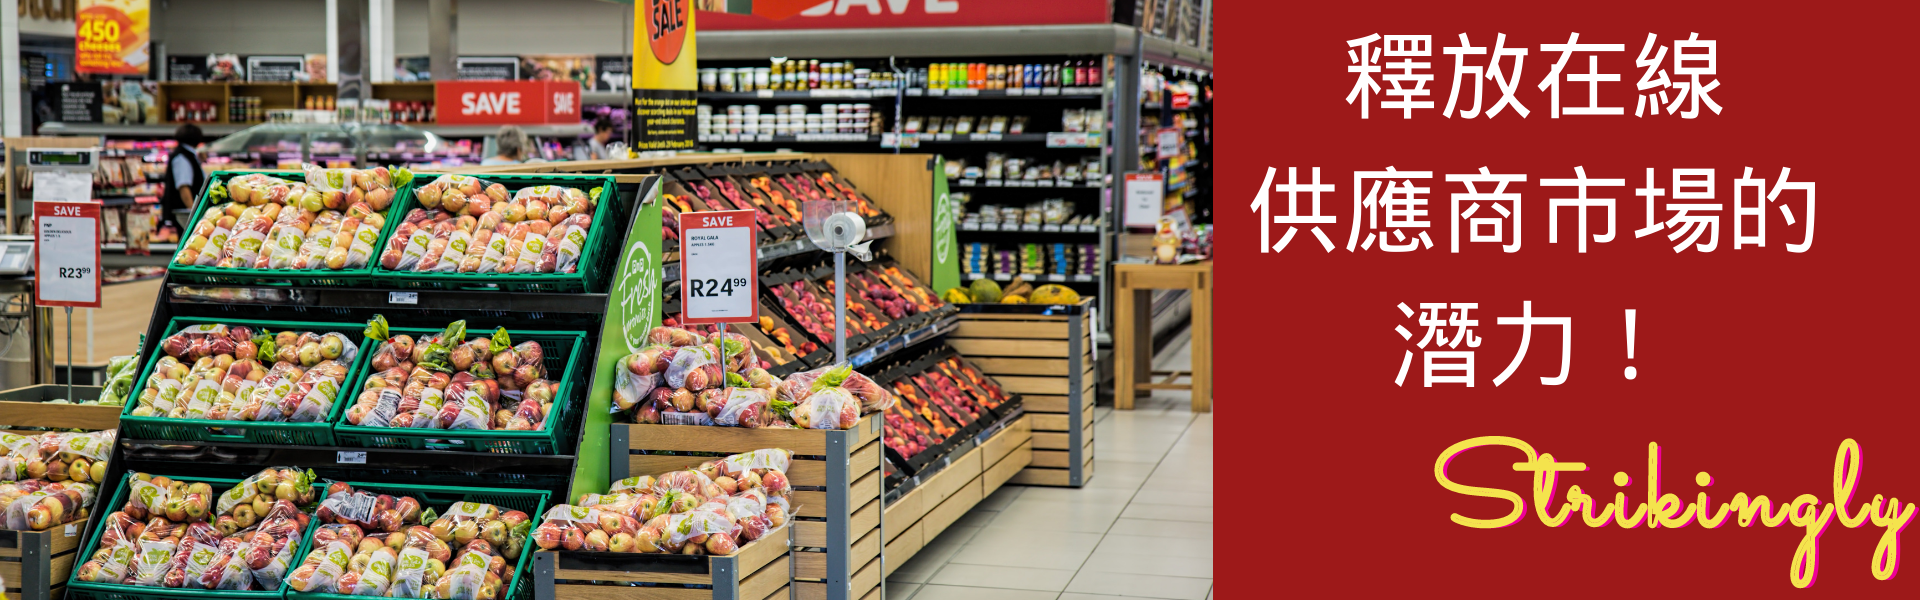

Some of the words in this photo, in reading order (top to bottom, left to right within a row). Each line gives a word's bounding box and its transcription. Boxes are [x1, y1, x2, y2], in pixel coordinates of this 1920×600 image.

[78, 19, 120, 42] 450
[652, 0, 683, 41] SALE
[461, 91, 521, 115] SAVE
[53, 206, 81, 216] SAVE
[702, 216, 733, 227] SAVE
[618, 253, 658, 315] Fresh
